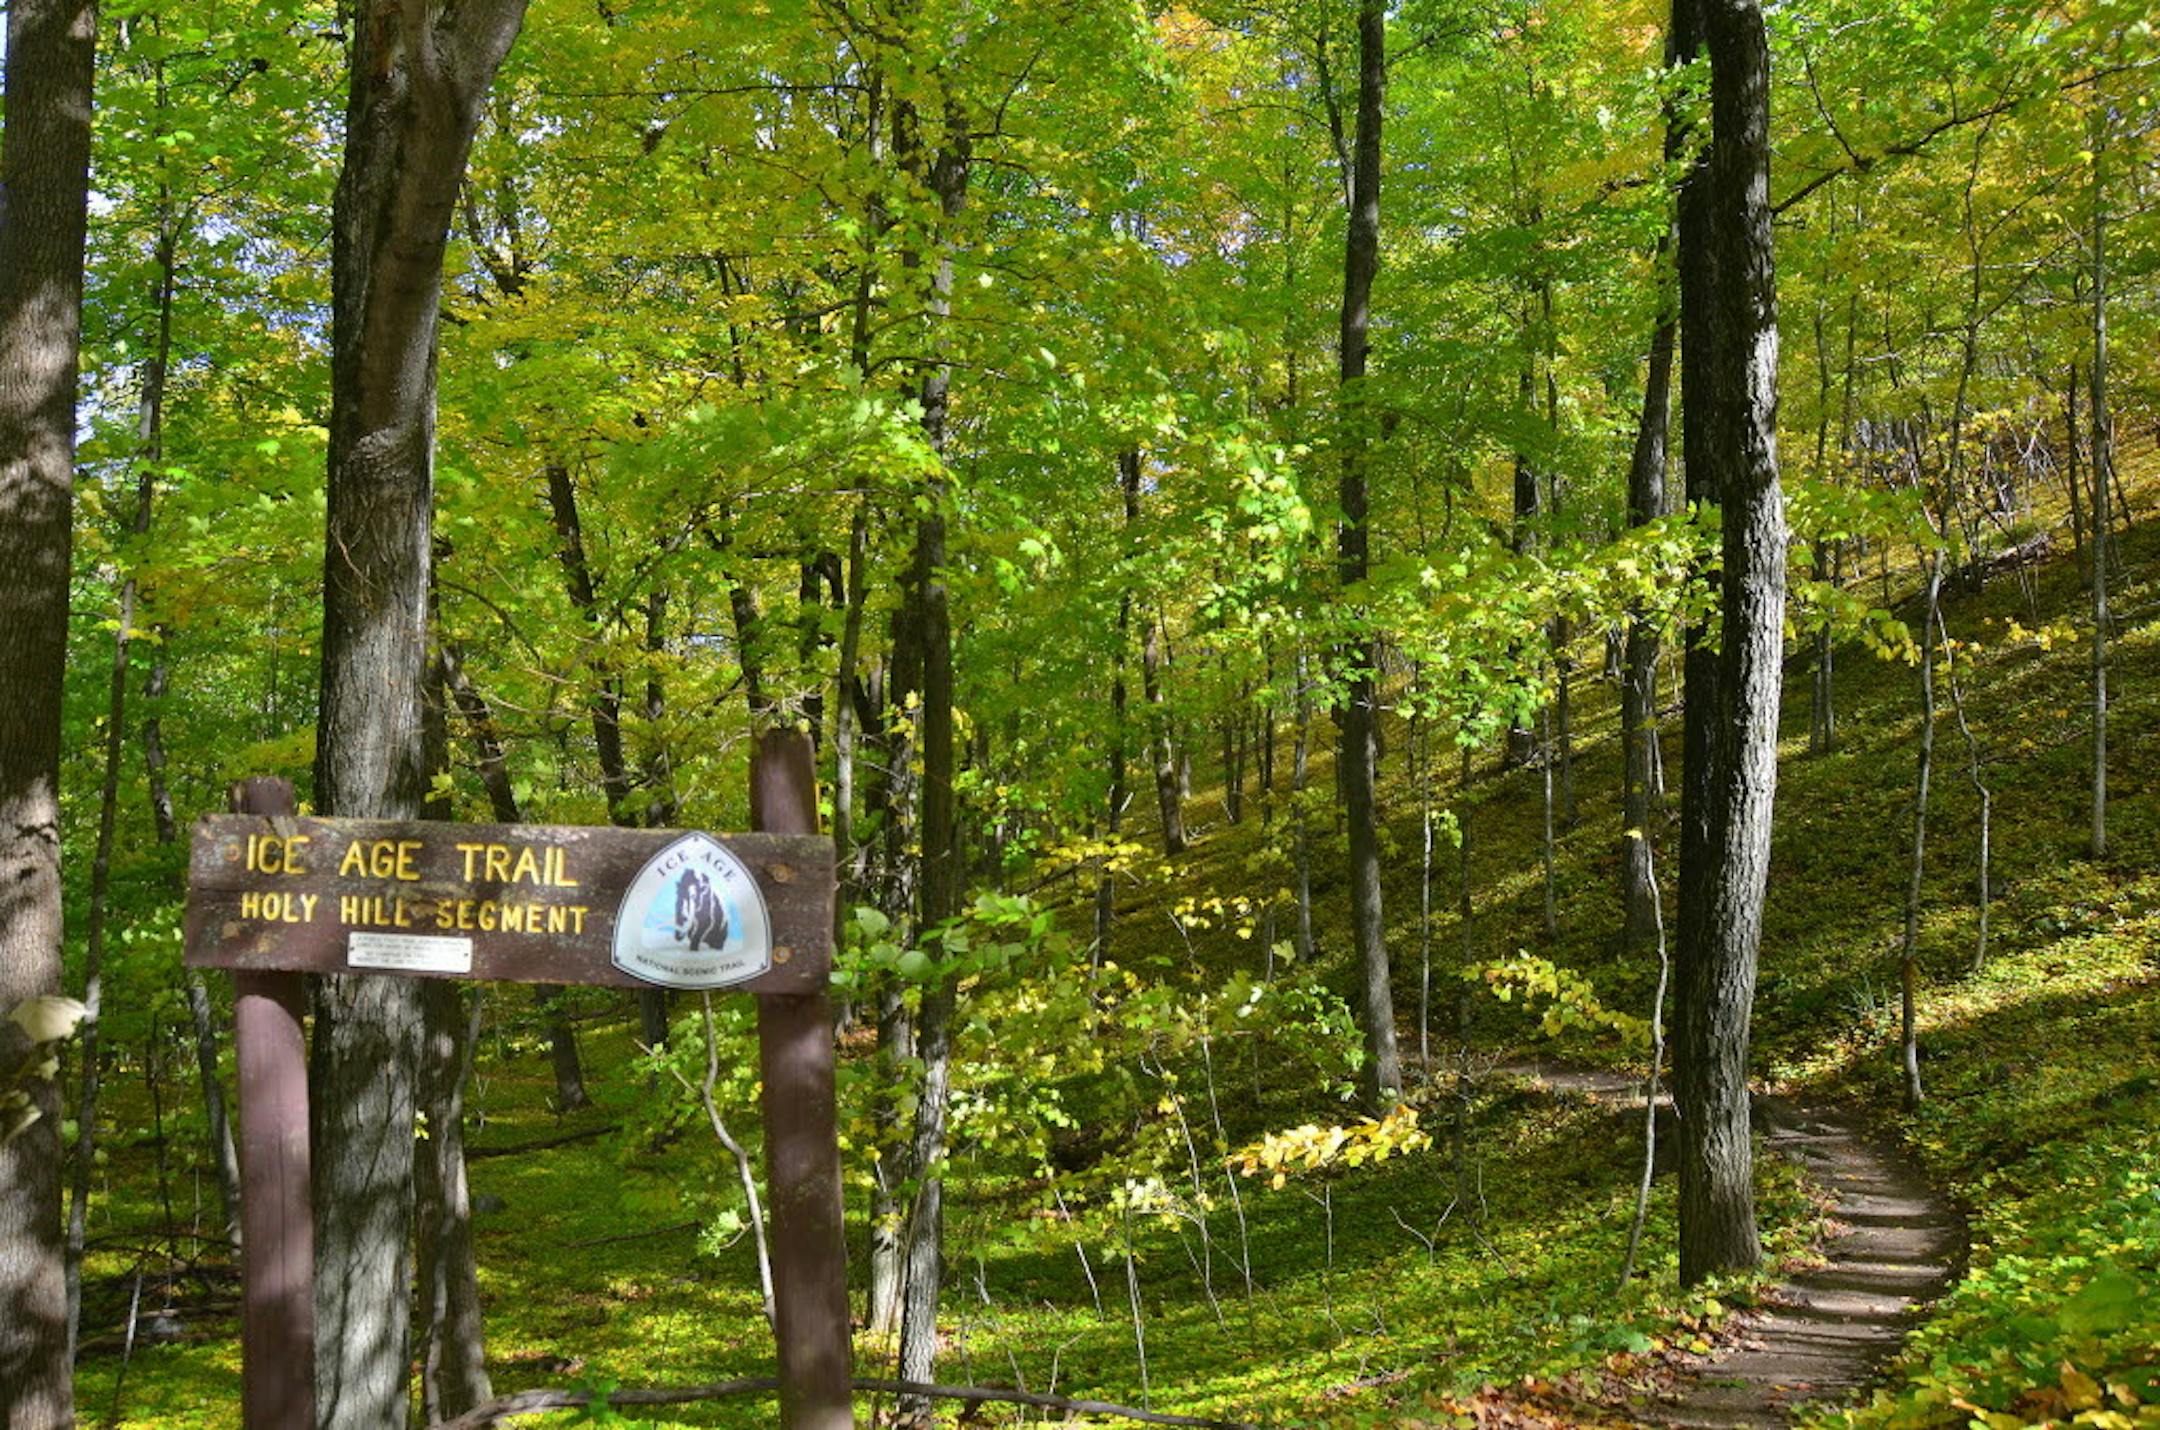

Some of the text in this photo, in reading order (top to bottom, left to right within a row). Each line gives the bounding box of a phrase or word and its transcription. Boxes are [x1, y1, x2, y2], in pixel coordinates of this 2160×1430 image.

[246, 834, 581, 888] ICE AGE TRAIL
[657, 850, 737, 883] ICE AGE
[241, 892, 589, 935] HOLY HILL SEGMENT
[636, 954, 745, 976] NATIONAL SCENIC TRAIL
